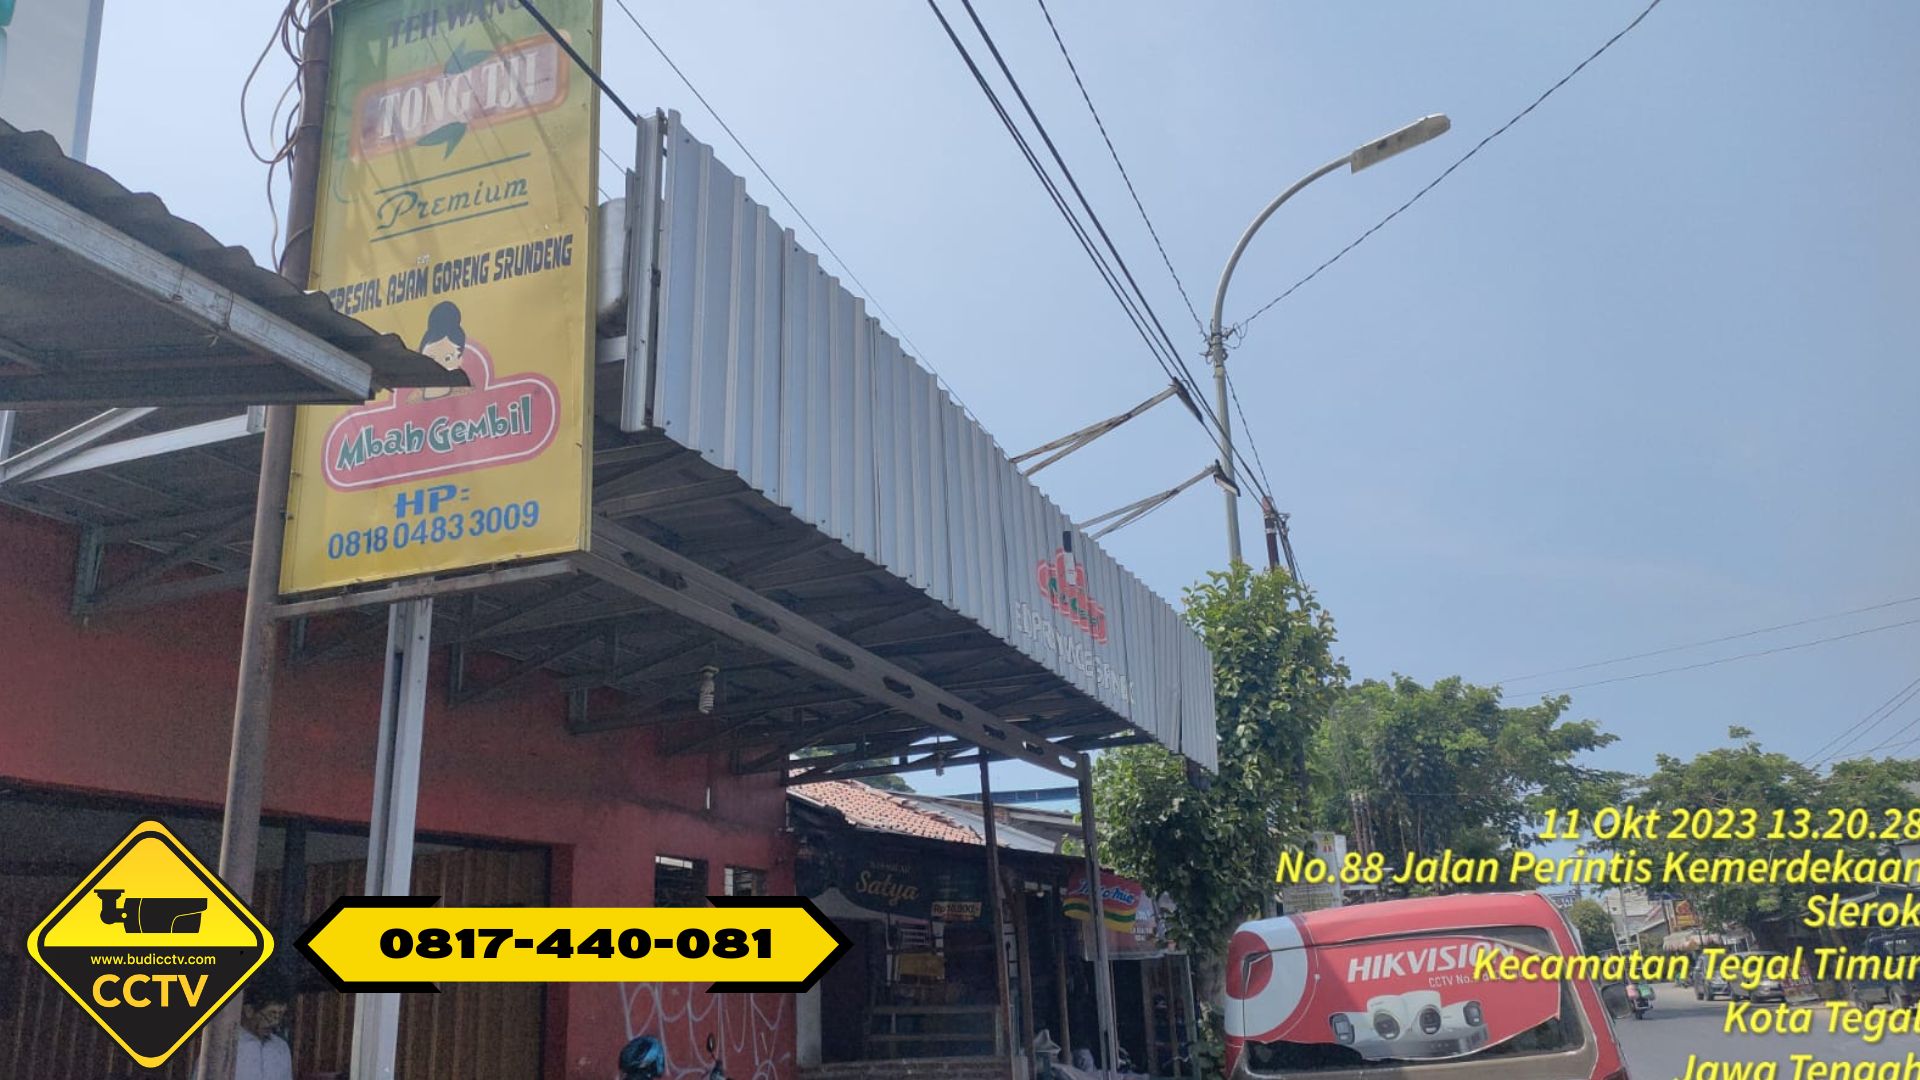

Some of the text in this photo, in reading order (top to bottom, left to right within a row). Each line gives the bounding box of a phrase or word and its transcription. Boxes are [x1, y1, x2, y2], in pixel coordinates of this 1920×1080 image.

[388, 9, 438, 49] TEH
[377, 71, 474, 138] TONG
[376, 177, 529, 230] Premium
[387, 265, 429, 306] AYAM
[432, 252, 490, 295] GORENG
[493, 234, 574, 282] SRUNDENG
[335, 394, 532, 471] Mbah Gembil
[328, 500, 540, 560] 0818 0483 3009
[856, 870, 920, 906] Satya
[1429, 976, 1453, 987] CCTV
